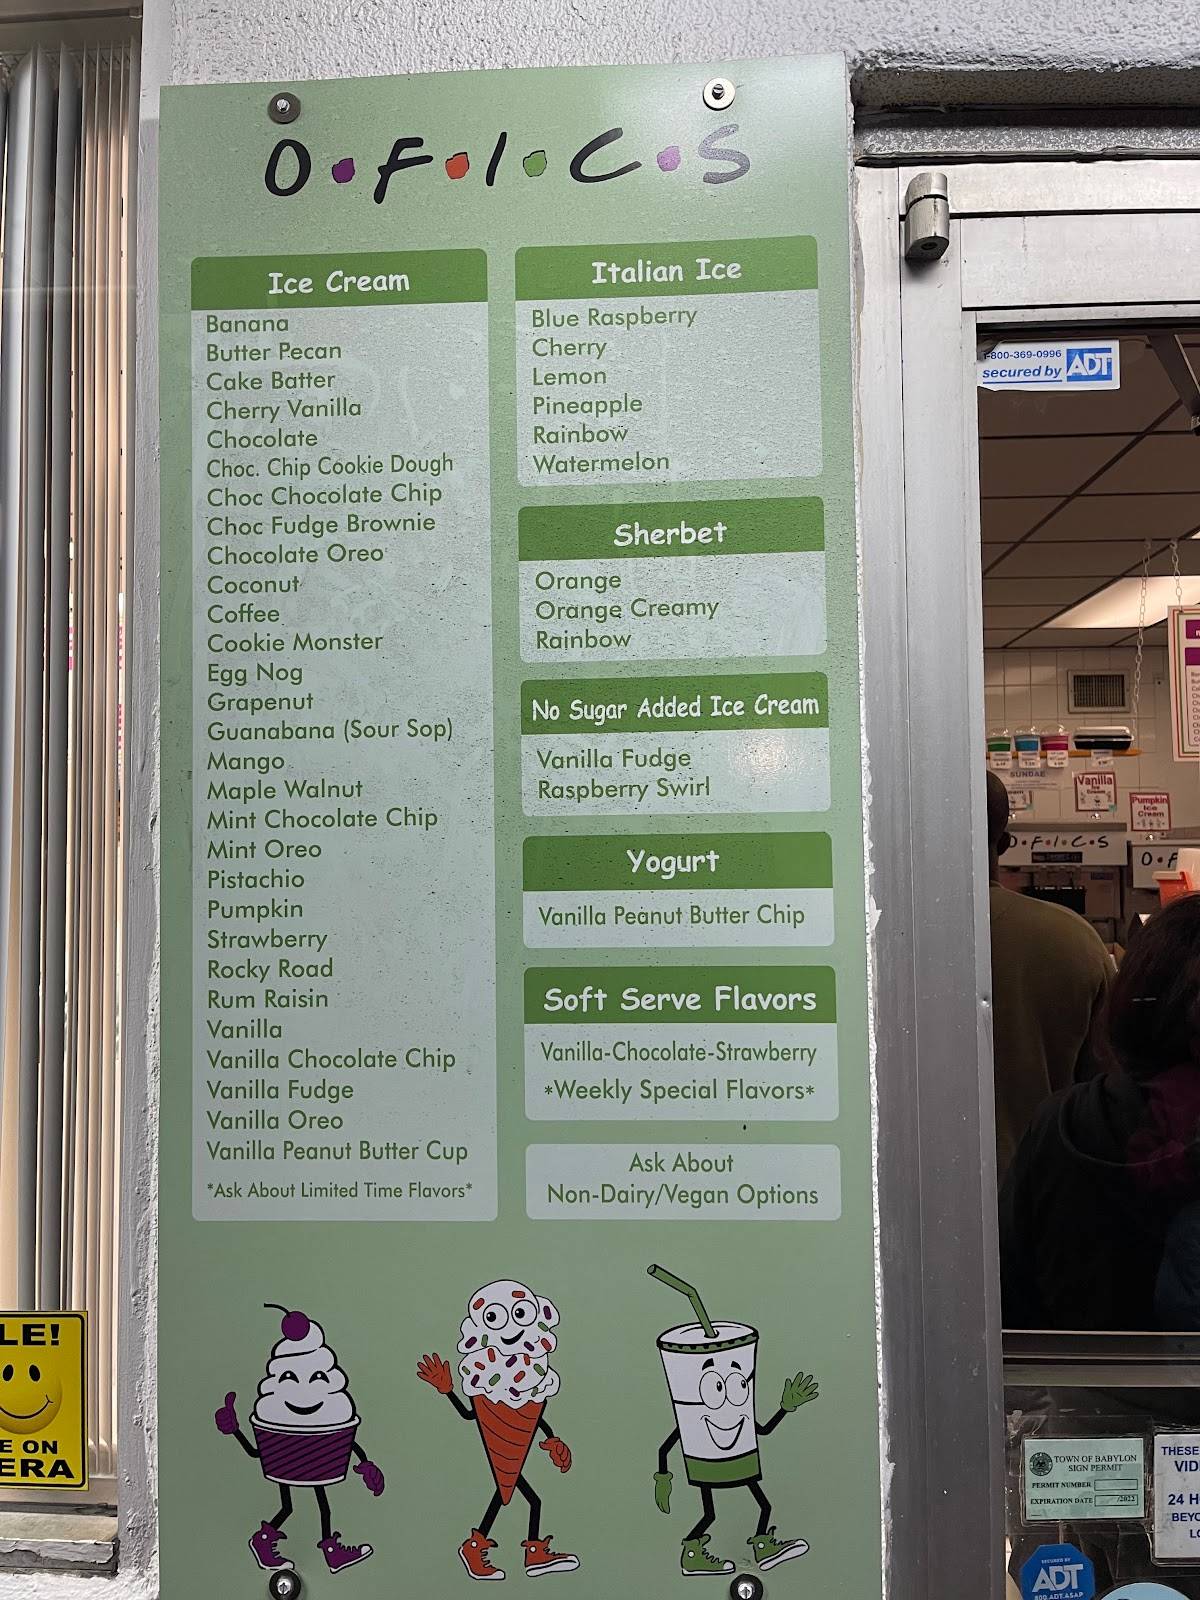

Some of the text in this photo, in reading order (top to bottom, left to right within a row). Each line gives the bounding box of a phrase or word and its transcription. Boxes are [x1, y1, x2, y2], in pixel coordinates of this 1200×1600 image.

[592, 258, 741, 284] Italian Ice
[269, 271, 409, 294] Ice Cream
[207, 315, 288, 333] Banana
[533, 306, 697, 331] Blue Raspberry
[207, 342, 341, 361] Butter Pecan
[533, 338, 607, 360] Cherry
[983, 352, 1112, 378] secured by ADT
[207, 371, 335, 391] Cake Batter
[533, 368, 606, 385] Lemon
[207, 397, 360, 423] Cherry Vanilla
[534, 393, 642, 418] Pineapple
[207, 428, 317, 448] Chocolate
[534, 423, 629, 444] Rainbow
[207, 452, 452, 480] Choc. Chip Cookie Dough
[533, 451, 669, 474] Watermelon
[208, 482, 441, 506] Choc Chocolate Chip
[208, 514, 435, 538] Choc Fudge Brownie
[614, 521, 727, 547] Sherbet
[208, 544, 383, 565] Chocolate Oreo
[208, 576, 299, 594] Coconut
[536, 572, 621, 594] Orange
[208, 603, 279, 623] Coffee
[536, 598, 719, 623] Orange Creamy
[208, 632, 383, 652] Cookie Monster
[537, 629, 631, 649] Rainbow
[208, 663, 302, 686] Egg Nog
[208, 693, 313, 715] Grapenut
[532, 693, 819, 726] No Sugar Added Ice Cream
[208, 718, 452, 743] Guanabana (Sour Sop)
[207, 752, 284, 774] Mango
[537, 747, 690, 771] Vanilla Fudge
[207, 778, 363, 804] Maple Walnut
[539, 776, 709, 803] Raspberry Swirl
[1078, 775, 1113, 786] Vanilla
[1132, 796, 1168, 805] Pumpkin
[207, 807, 437, 831] Mint Chocolate Chip
[207, 840, 321, 859] Mint Oreo
[627, 850, 719, 879] Yogurt
[209, 869, 304, 888] Pistachio
[209, 898, 302, 923] Pumpkin
[539, 904, 804, 928] Vanilla Peanut Butter Chip
[208, 928, 327, 952] Strawberry
[209, 957, 332, 983] Rocky Road
[209, 989, 328, 1008] Rum Raisin
[544, 985, 816, 1012] Soft Serve Flavors
[207, 1018, 281, 1039] Vanilla
[207, 1047, 455, 1072] Vanilla Chocolate Chip
[207, 1079, 353, 1103] Vanilla Fudge
[641, 1079, 716, 1104] Special
[206, 1109, 343, 1129] Vanilla Oreo
[207, 1140, 467, 1165] Vanilla Peanut Butter Cup
[629, 1152, 733, 1172] Ask About
[248, 1181, 295, 1197] About
[302, 1181, 359, 1198] Limited
[363, 1181, 404, 1198] Time
[548, 1183, 819, 1208] Non-Dairy/Vegan Options
[22, 1440, 58, 1454] ON
[1161, 1446, 1200, 1456] THESE
[1054, 1455, 1080, 1463] TOWN
[1095, 1454, 1137, 1462] BABYLON
[1069, 1464, 1123, 1472] SIGN PERMIT
[1174, 1460, 1200, 1473] VID
[1030, 1497, 1073, 1505] EXPIRATION
[1168, 1493, 1185, 1506] 24
[1032, 1563, 1084, 1593] ADT
